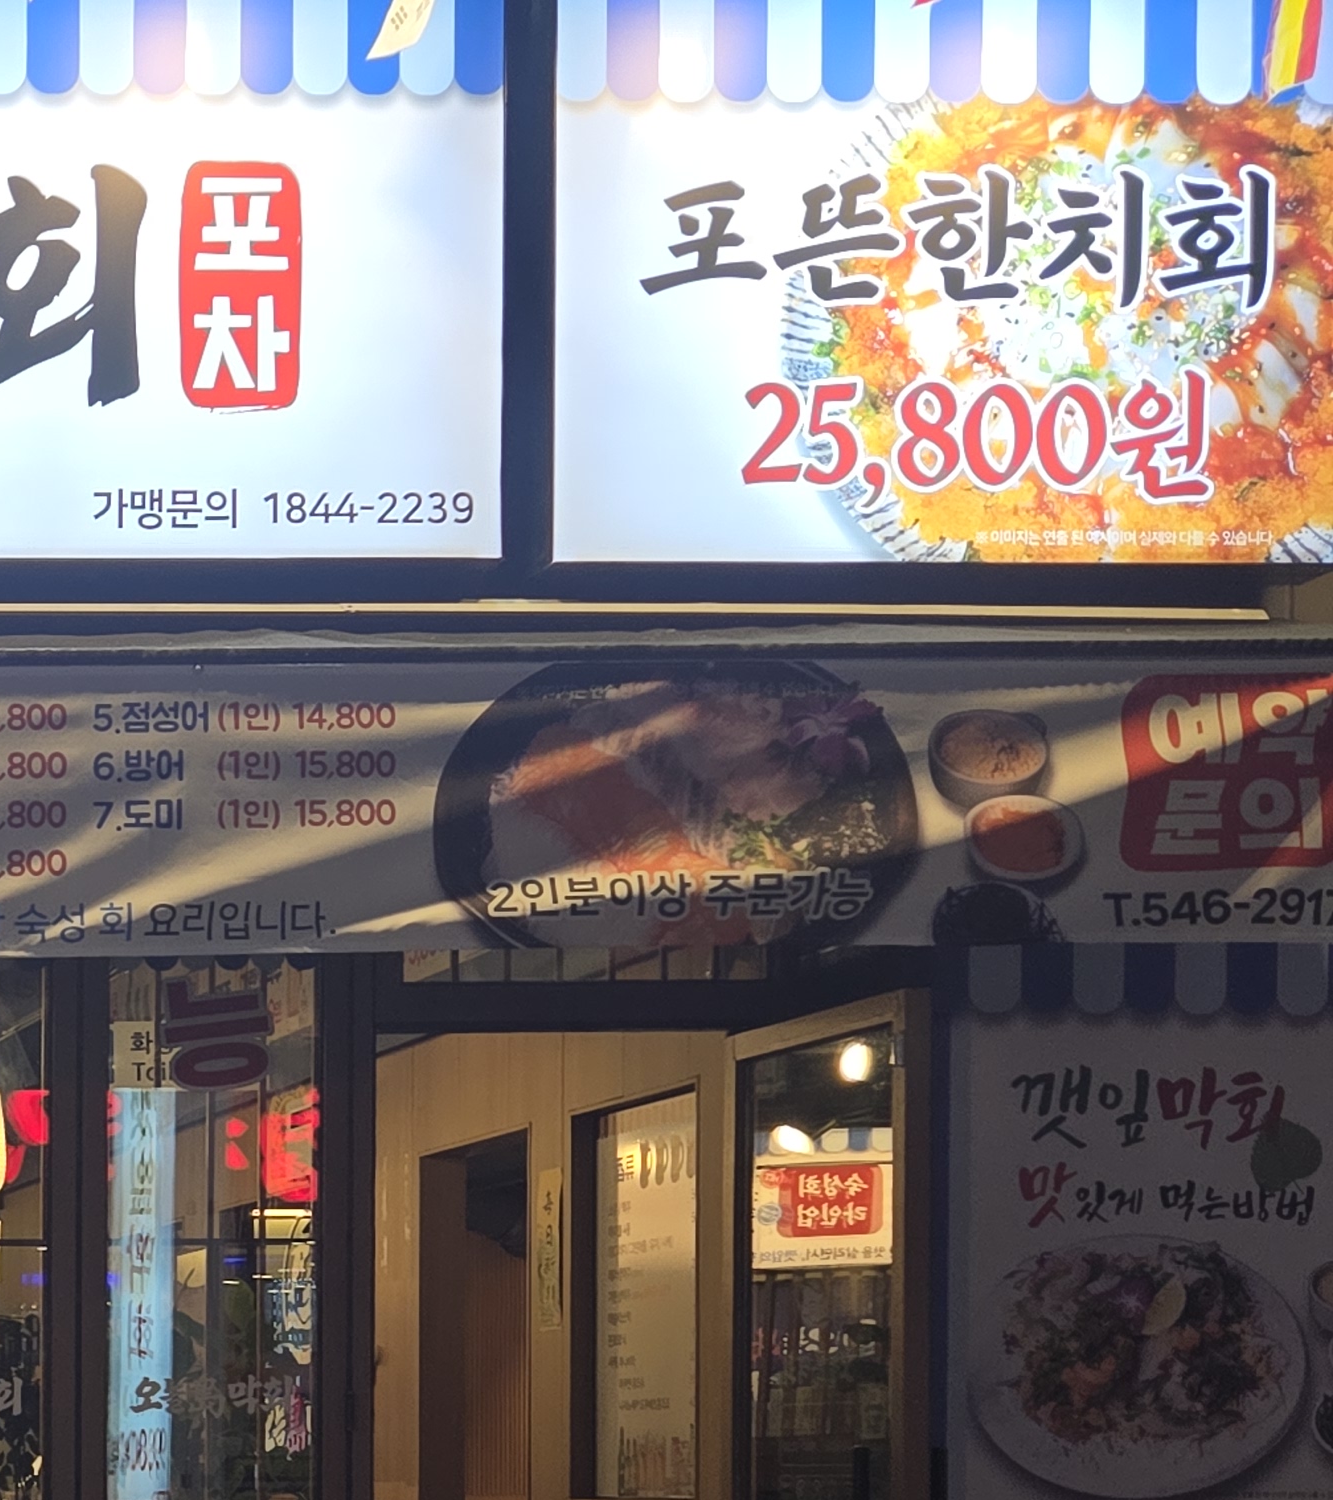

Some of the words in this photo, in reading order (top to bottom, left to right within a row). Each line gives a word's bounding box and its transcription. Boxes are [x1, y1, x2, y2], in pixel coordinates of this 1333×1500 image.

[194, 176, 290, 393] 포차
[741, 369, 1213, 505] 25,800원
[92, 488, 240, 530] 가맹문의
[263, 491, 476, 528] 1844-2239
[92, 701, 209, 735] 5.점성어
[217, 702, 281, 733] (1인)
[295, 702, 396, 732] 14,800
[1149, 688, 1332, 765] 예약
[93, 750, 184, 783] 6.방어
[217, 750, 281, 781] (1인)
[295, 750, 396, 780] 15,800
[93, 799, 182, 832] 7.도미
[217, 799, 281, 830] (1인)
[295, 799, 396, 828] 15,800
[1151, 777, 1324, 855] 문의
[14, 903, 86, 944] 숙성
[99, 901, 133, 940] 회
[144, 901, 337, 940] 요리입니다.
[487, 874, 691, 920] 2인분이상
[706, 870, 872, 920] 주문가능
[1011, 1064, 1286, 1149] 깻잎막회
[1019, 1162, 1143, 1228] 맛있게
